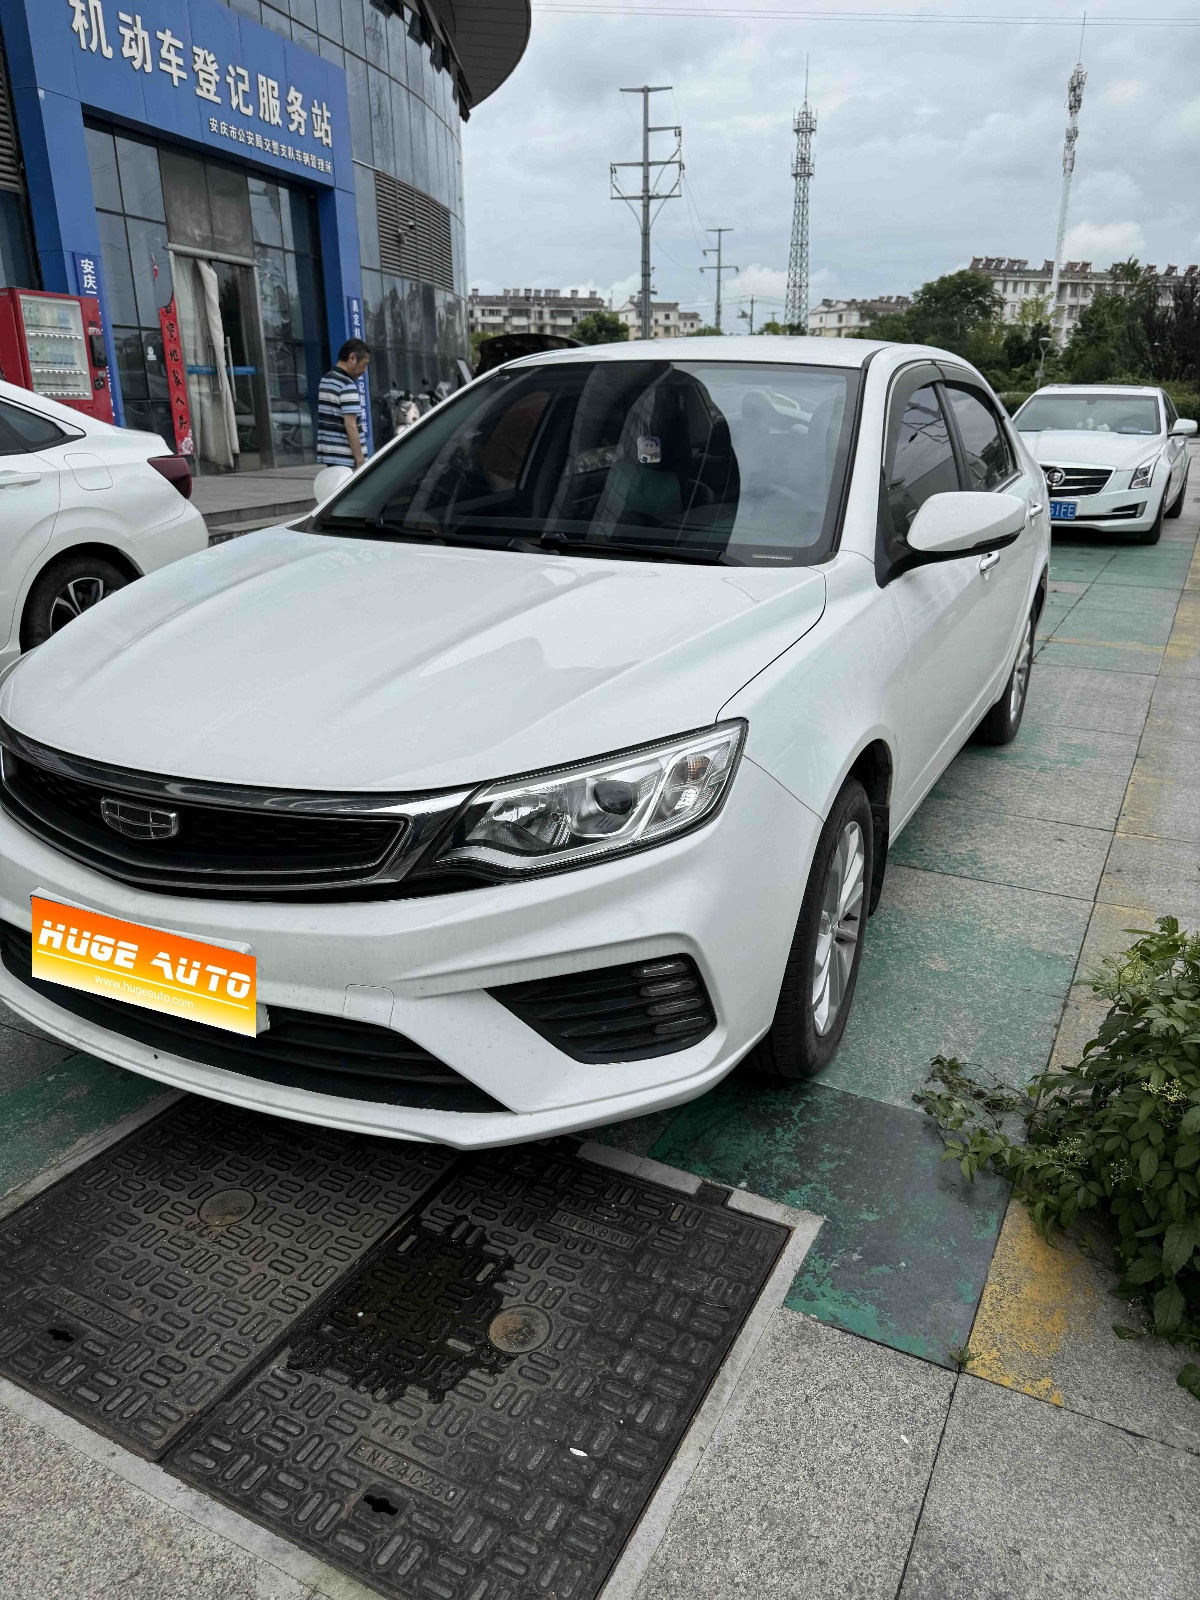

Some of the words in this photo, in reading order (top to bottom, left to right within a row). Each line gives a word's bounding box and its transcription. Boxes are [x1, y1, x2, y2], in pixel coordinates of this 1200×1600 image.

[68, 0, 333, 149] 机动车登记服务站
